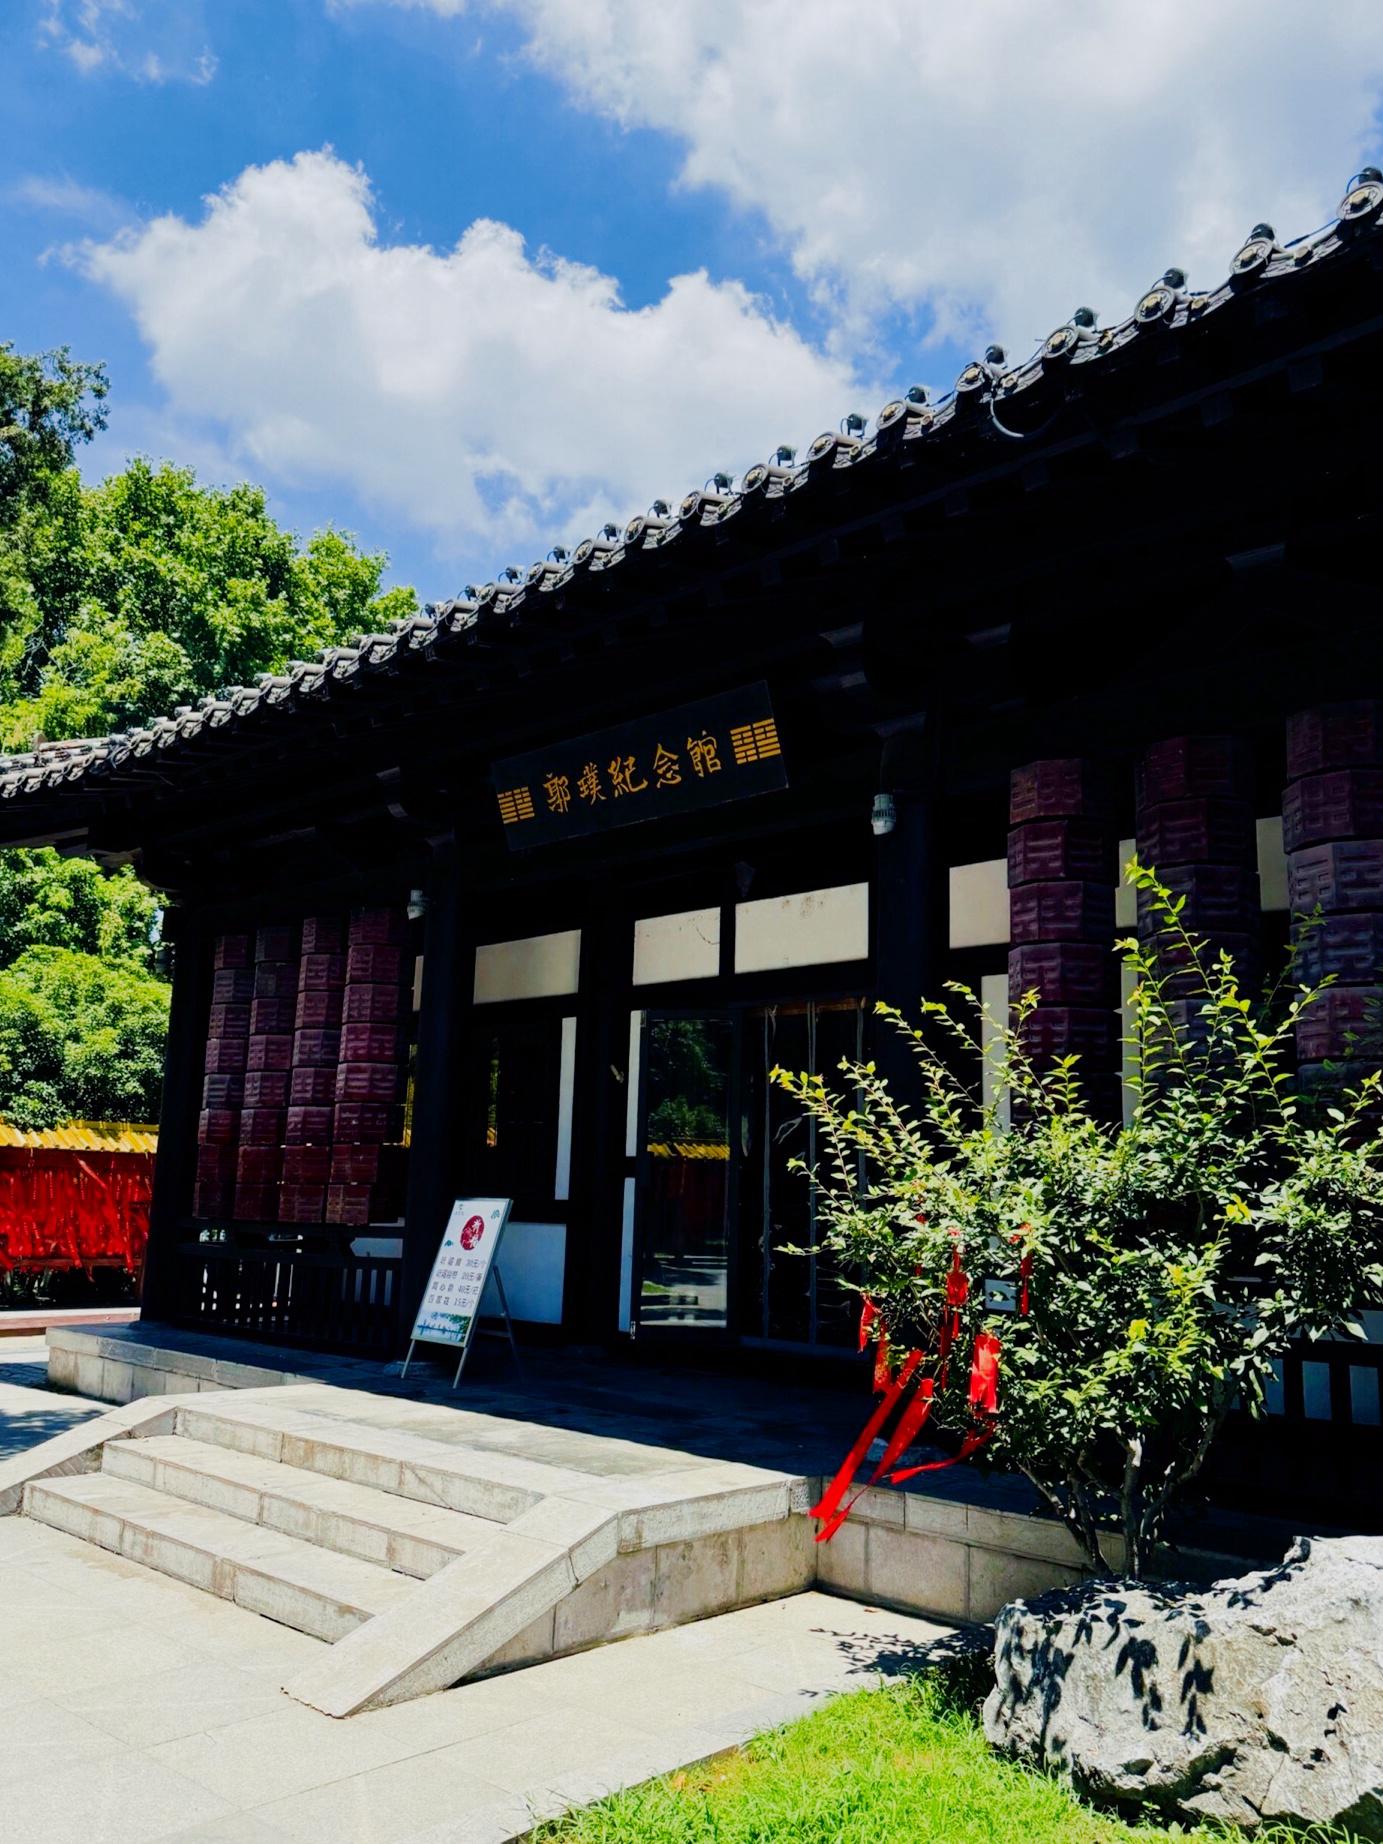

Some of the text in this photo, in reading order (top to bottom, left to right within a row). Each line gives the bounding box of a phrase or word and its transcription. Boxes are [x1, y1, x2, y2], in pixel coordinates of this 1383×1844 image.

[542, 730, 722, 814] 郭璞紀念館
